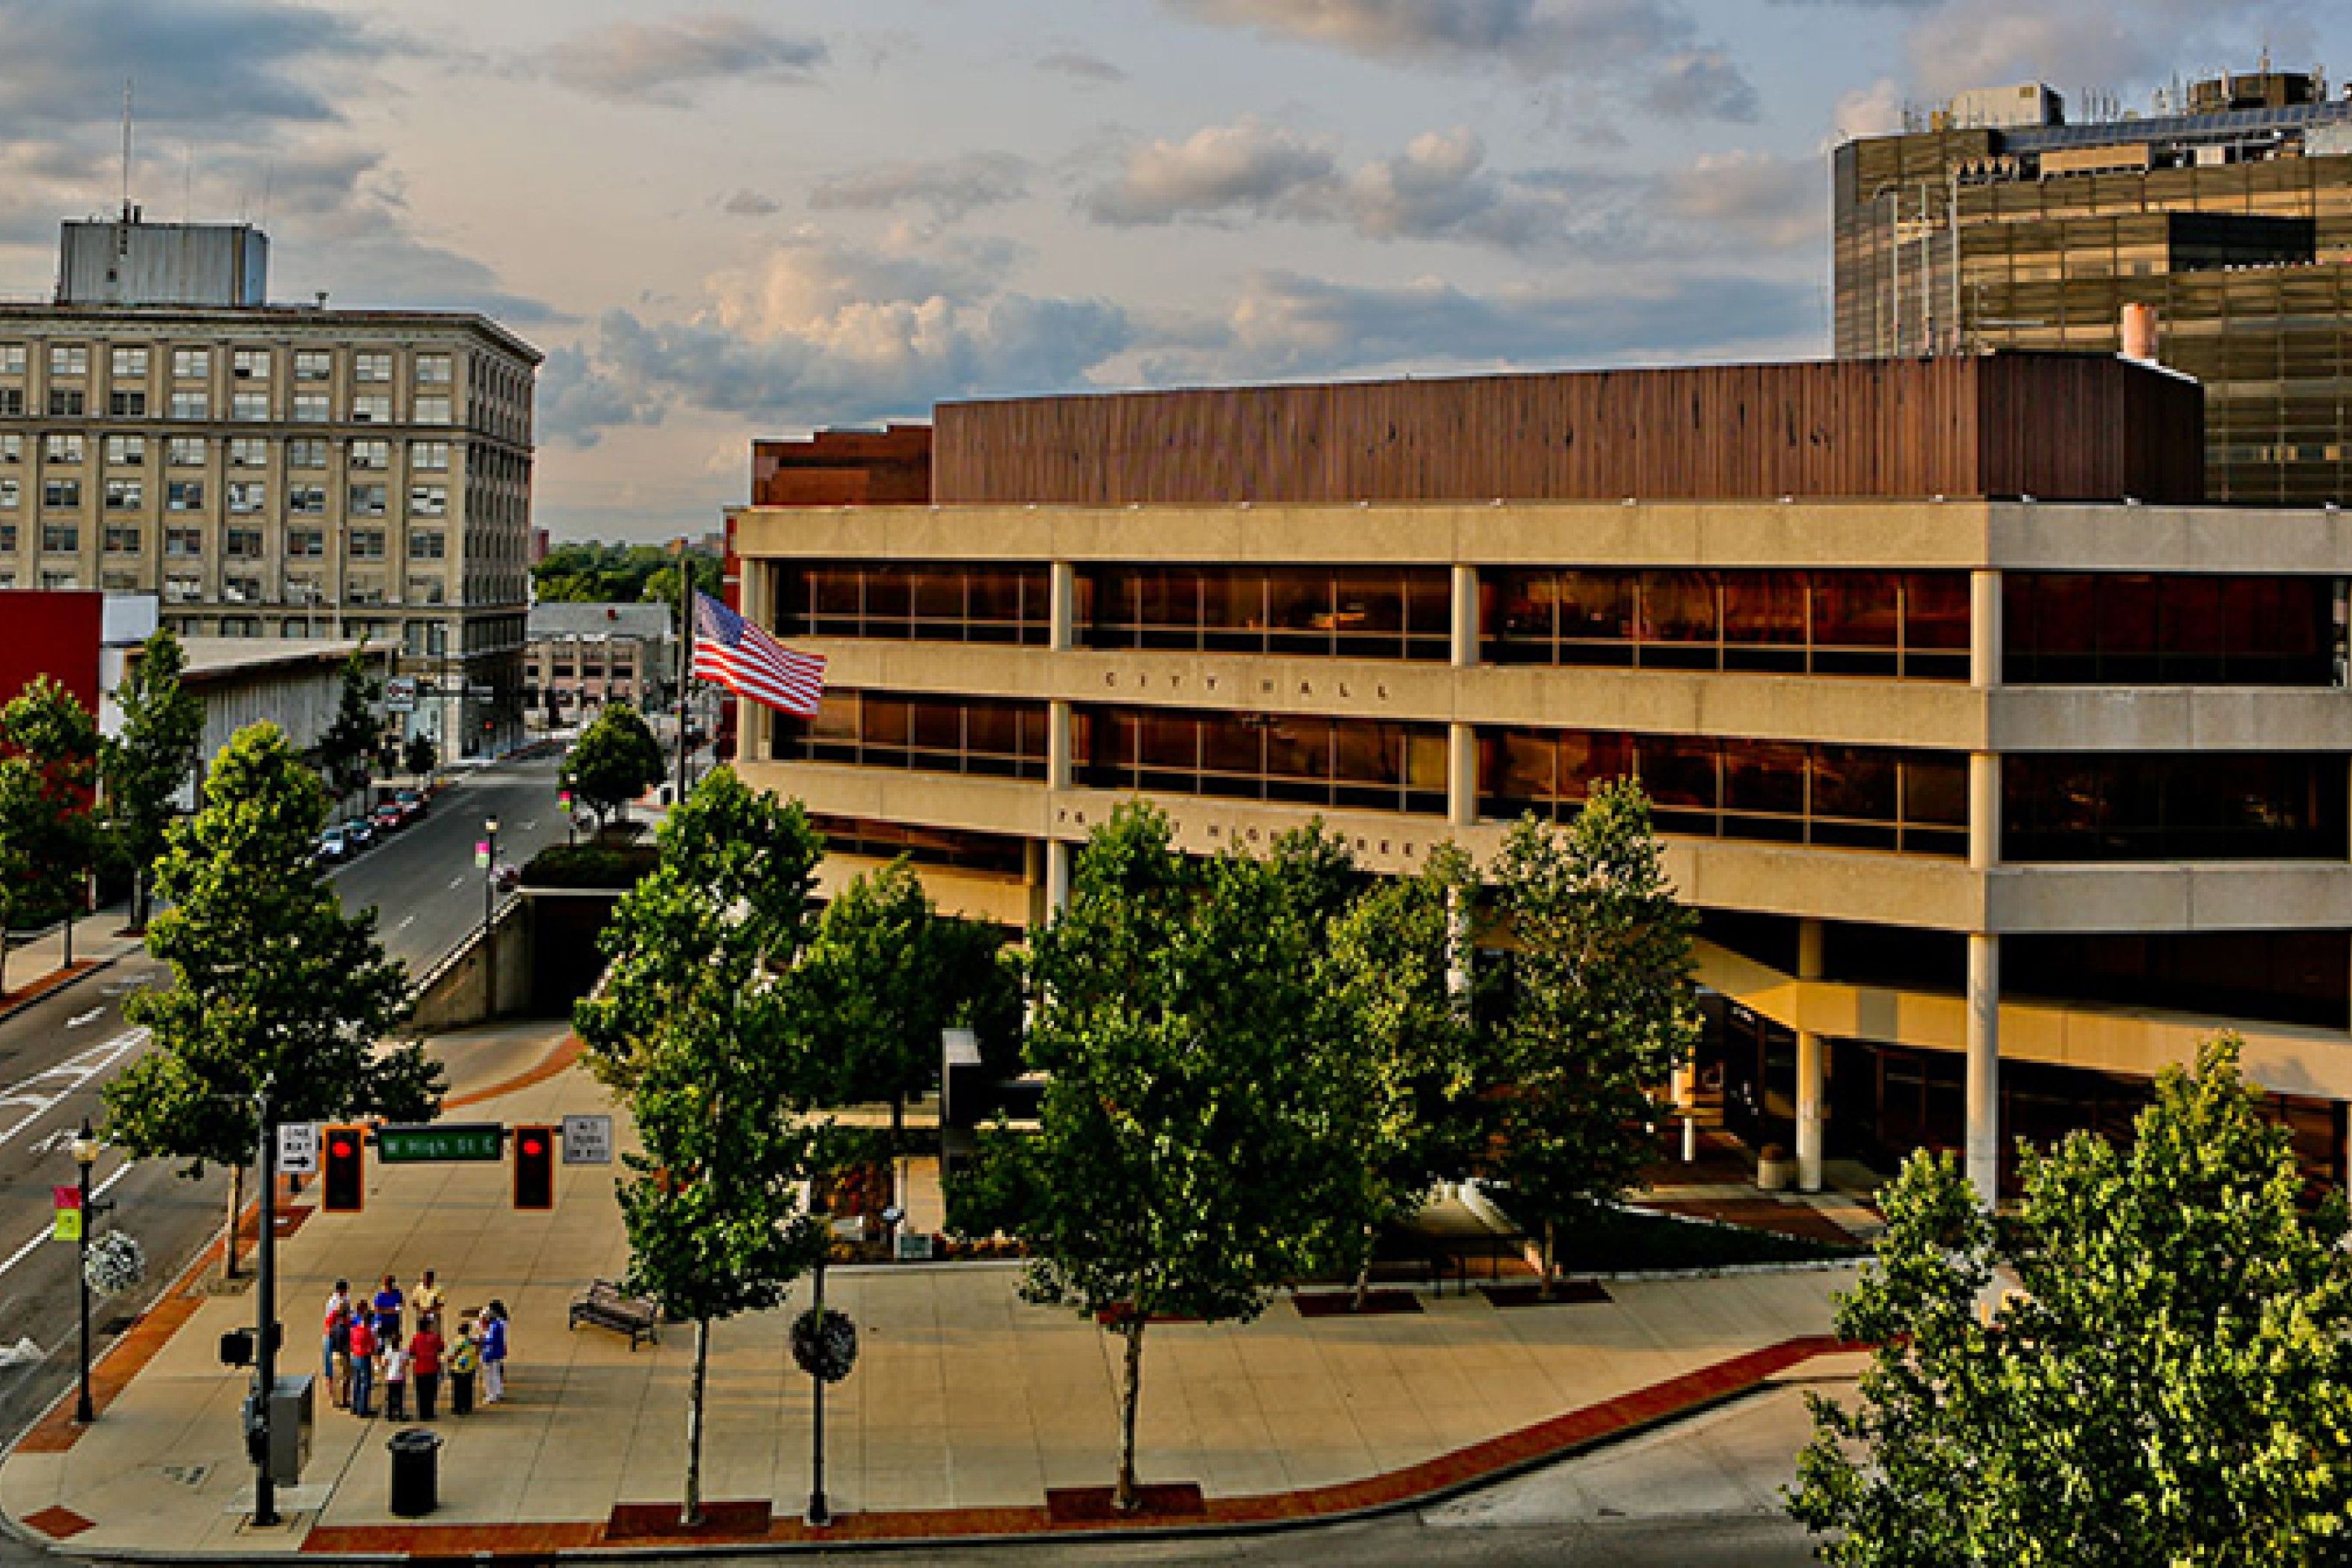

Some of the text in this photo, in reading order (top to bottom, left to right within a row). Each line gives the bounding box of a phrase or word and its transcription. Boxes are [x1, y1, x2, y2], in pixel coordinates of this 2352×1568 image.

[1105, 672, 1389, 701] CITY HALL
[406, 1139, 448, 1157] High
[457, 1138, 476, 1154] St
